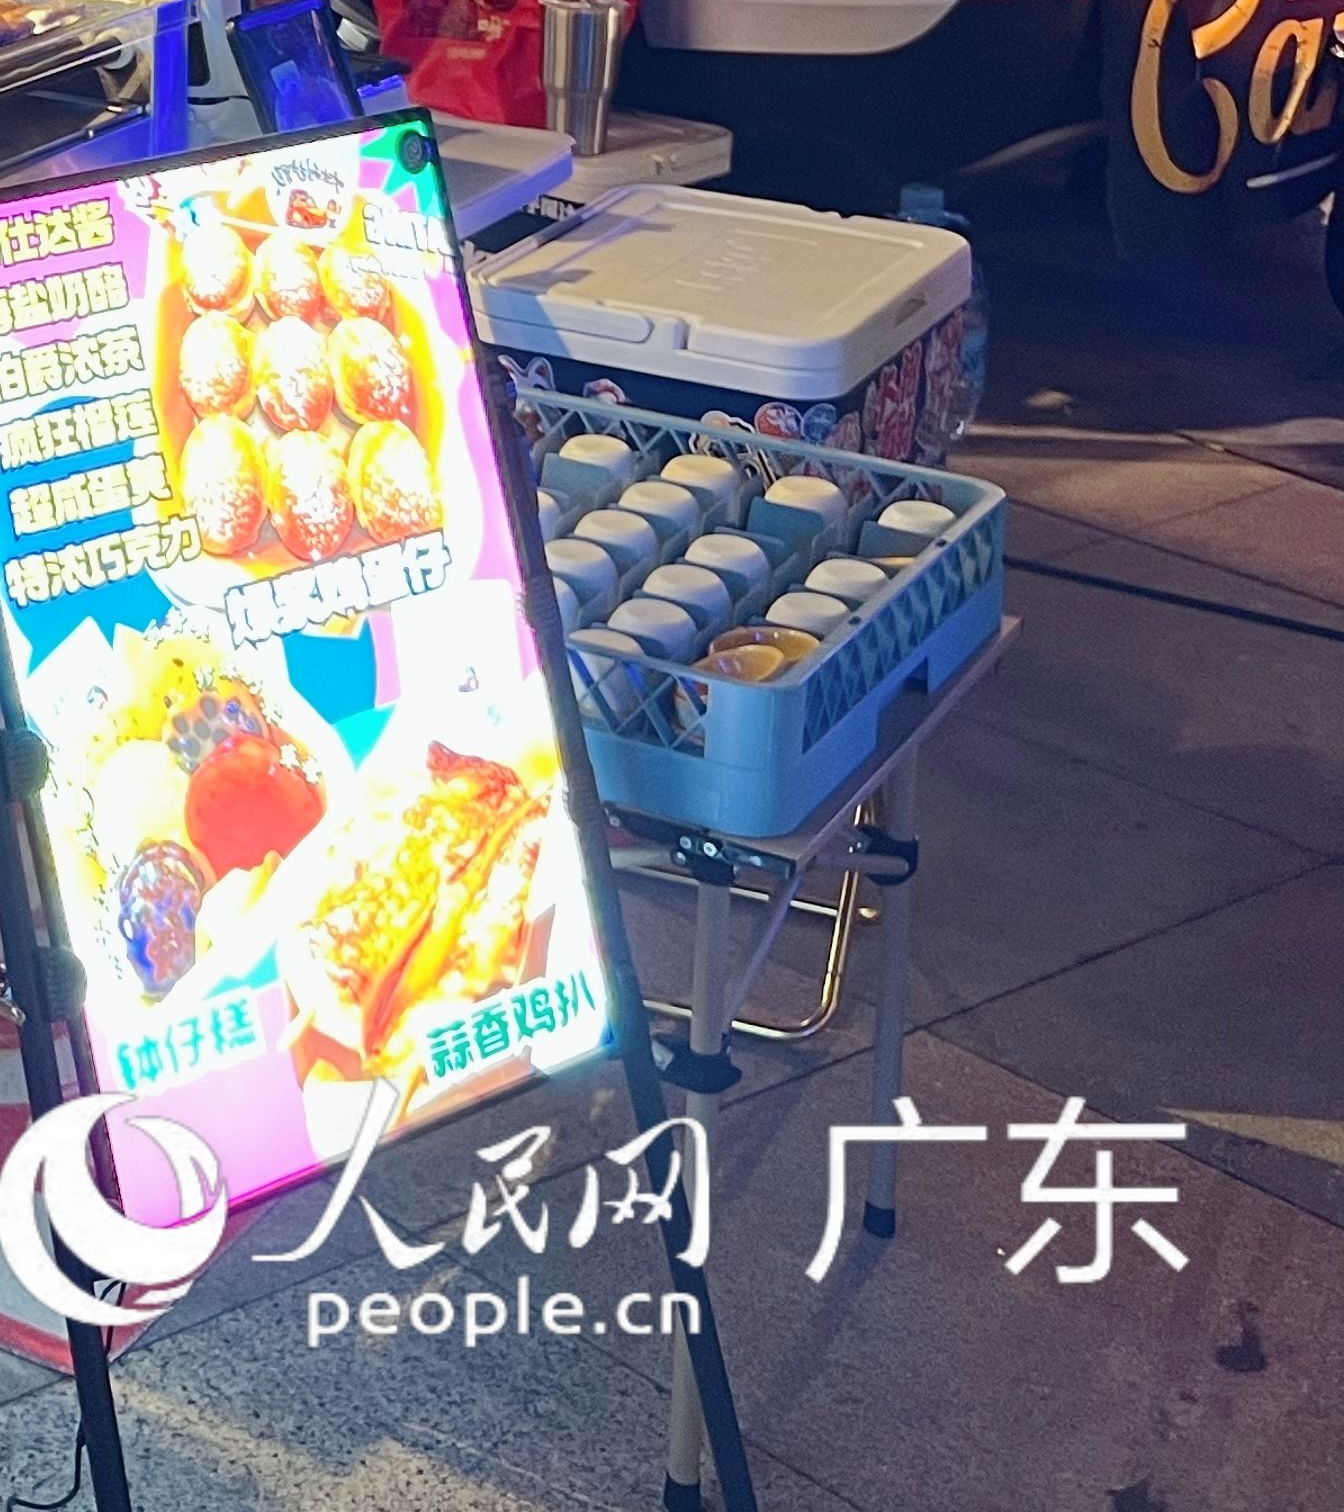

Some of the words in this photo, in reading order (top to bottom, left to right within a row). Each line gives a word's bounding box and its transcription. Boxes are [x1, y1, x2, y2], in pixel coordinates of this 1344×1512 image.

[4, 514, 206, 609] 特浓巧克力
[115, 997, 256, 1091] 钵仔糕
[426, 970, 597, 1080] 蒜香鸡扒
